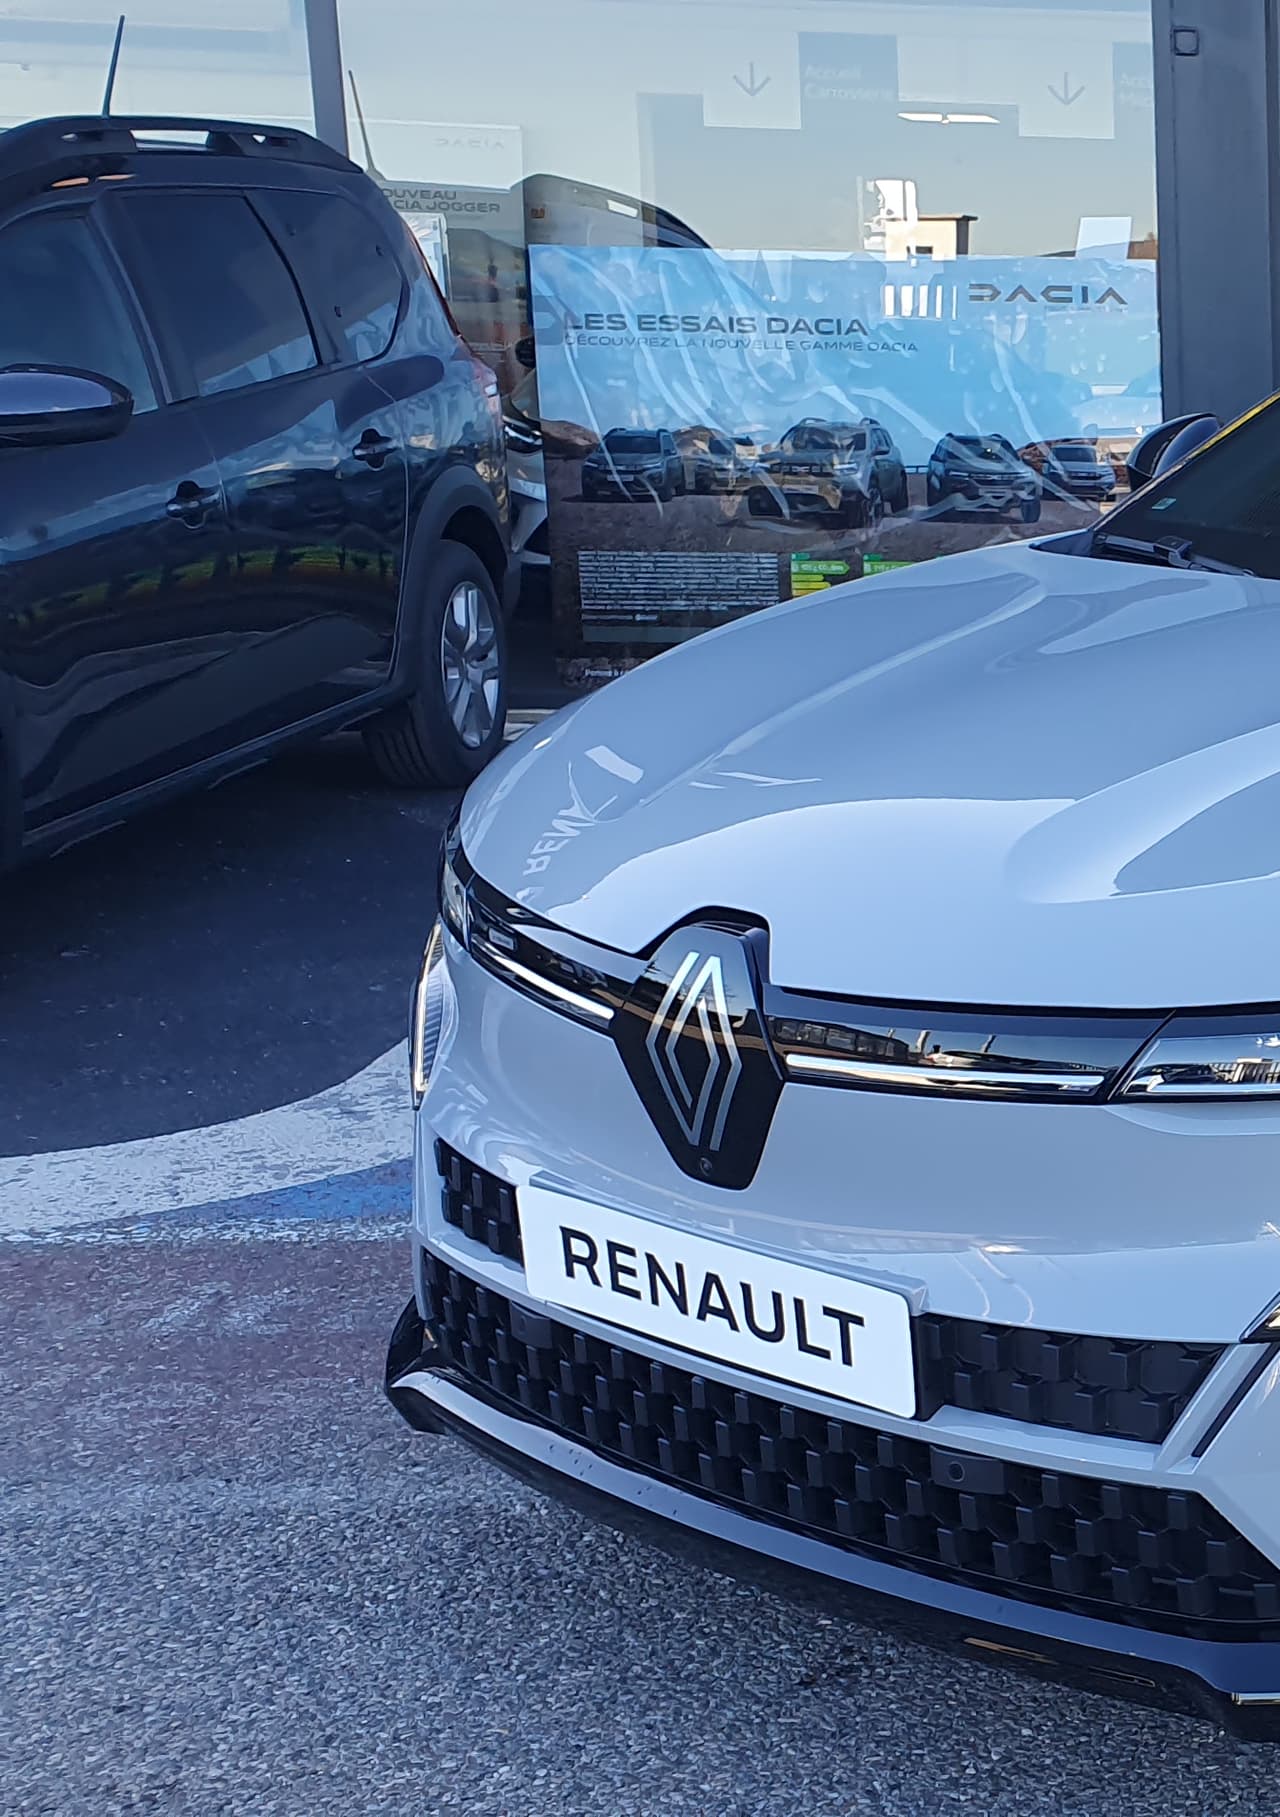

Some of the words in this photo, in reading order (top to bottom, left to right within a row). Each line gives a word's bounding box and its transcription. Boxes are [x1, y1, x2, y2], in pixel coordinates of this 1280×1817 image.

[381, 187, 457, 200] OUVEAU
[394, 199, 423, 210] CIA
[426, 201, 501, 213] JOGGER
[968, 283, 1129, 305] DACIA
[564, 313, 628, 331] LES
[637, 314, 758, 334] ESSAIS
[766, 317, 869, 337] DACIA
[565, 333, 671, 348] DÉCOUVREZ
[674, 336, 697, 349] LA
[702, 337, 796, 351] NOUVELLE
[801, 340, 864, 351] GAMME
[867, 341, 918, 353] DACIA
[558, 1224, 865, 1368] RENAULT
